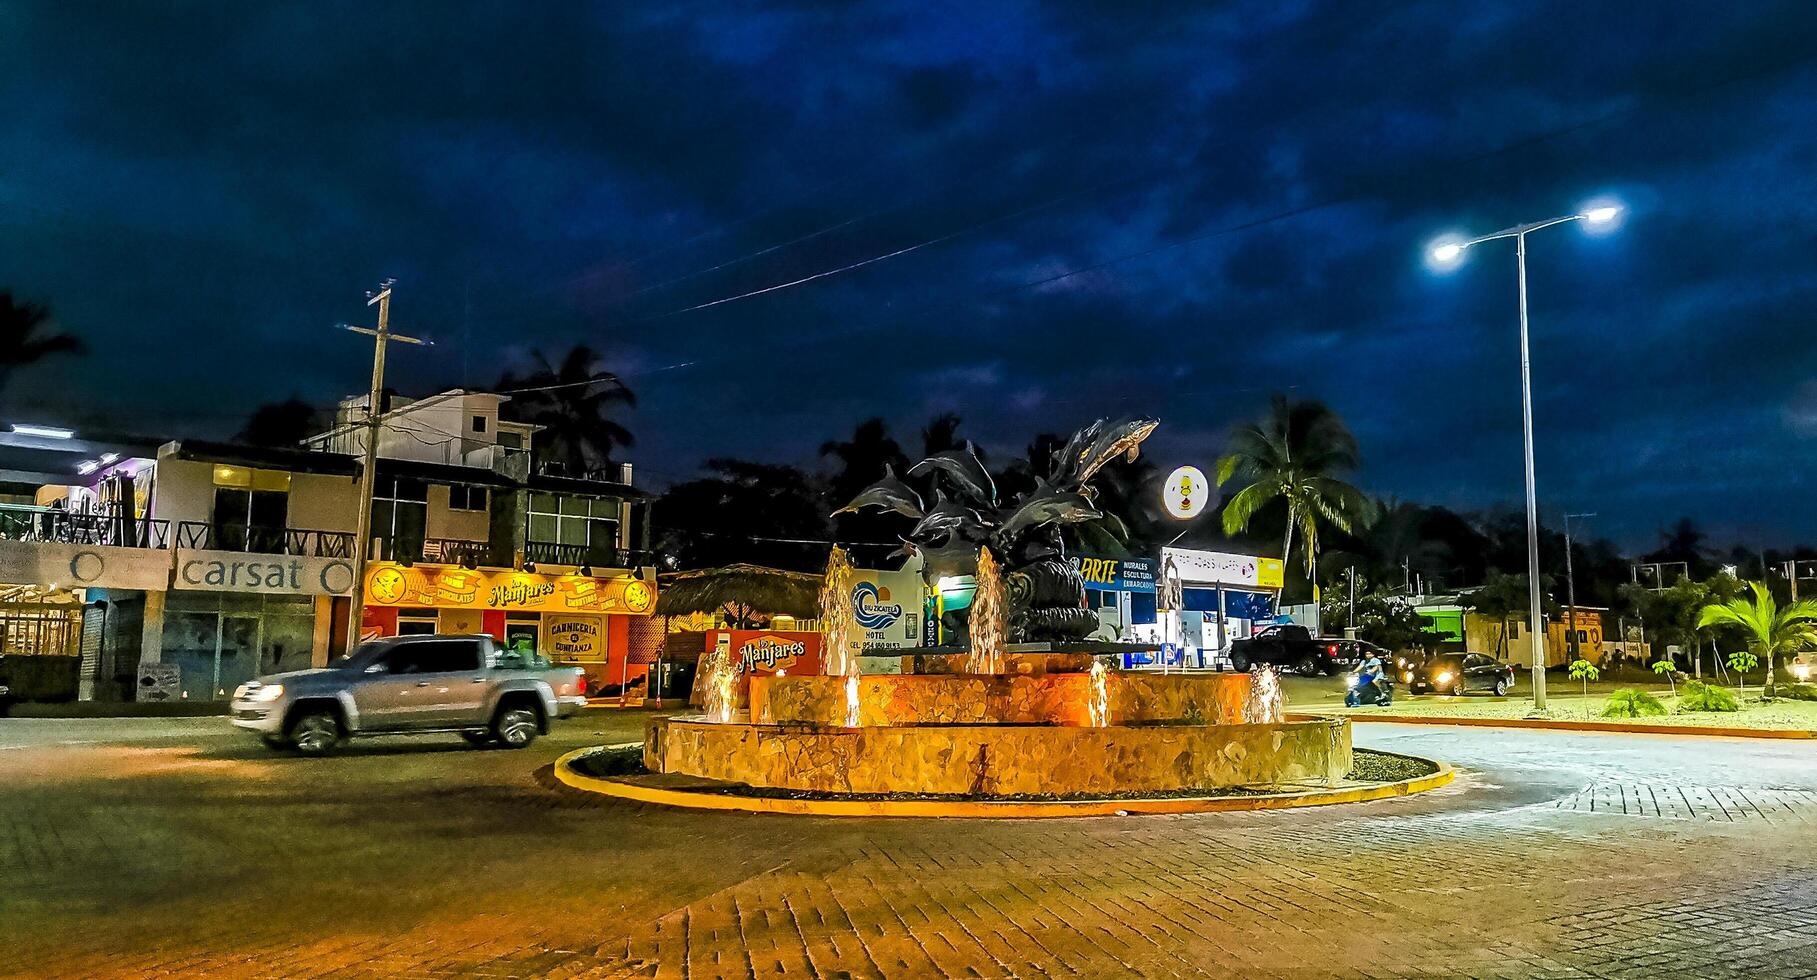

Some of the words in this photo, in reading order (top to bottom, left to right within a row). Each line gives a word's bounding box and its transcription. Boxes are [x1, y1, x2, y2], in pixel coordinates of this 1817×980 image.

[182, 559, 303, 589] carsat
[1080, 557, 1119, 583] ARTE
[1123, 570, 1153, 579] ESCULTURA
[487, 581, 555, 607] Manjares
[865, 631, 886, 639] HOTEL
[737, 640, 806, 672] Manjares
